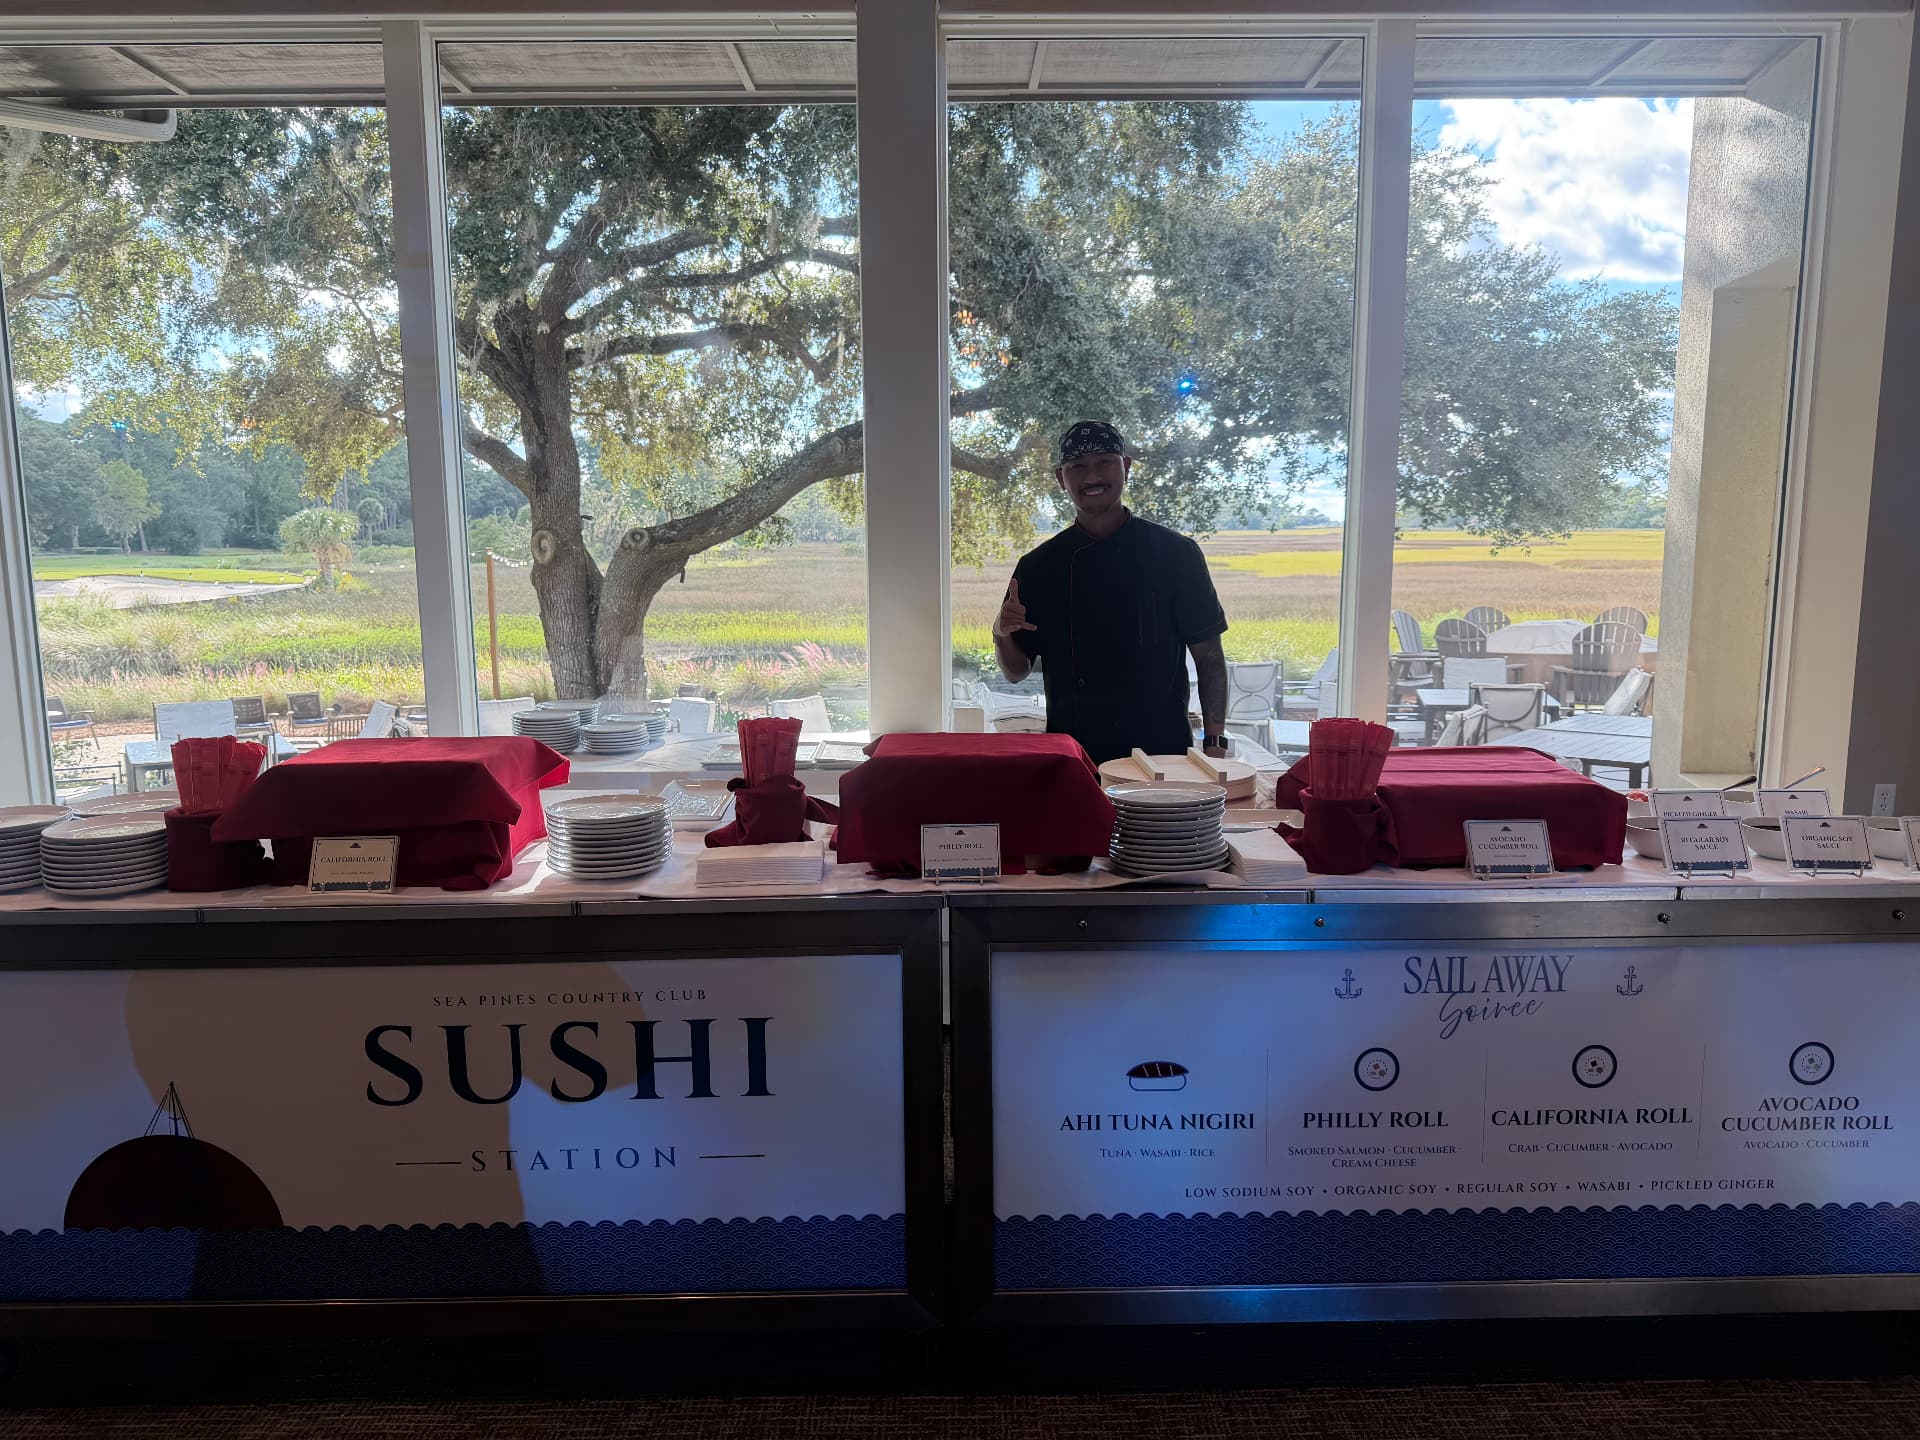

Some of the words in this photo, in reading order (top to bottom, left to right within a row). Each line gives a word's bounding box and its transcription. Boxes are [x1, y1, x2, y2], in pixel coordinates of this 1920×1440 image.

[1489, 835, 1526, 843] AVOCADO
[1694, 843, 1719, 851] SAUCE
[320, 856, 366, 864] CALIFORNIA
[1403, 956, 1476, 994] SAIL
[1481, 955, 1575, 993] AWAY
[433, 995, 468, 1008] SEA
[479, 993, 537, 1007] PINES
[547, 991, 645, 1005] COUNTRY
[655, 989, 708, 1002] CLUB
[364, 1016, 777, 1107] SUSHI
[1758, 1096, 1860, 1112] AVOCADO
[1060, 1114, 1101, 1132] AHI
[1108, 1113, 1174, 1131] TUNA
[1180, 1113, 1256, 1131] NIGIRI
[1302, 1112, 1385, 1129] PHILLY
[1389, 1110, 1449, 1128] ROLL
[1491, 1108, 1629, 1126] CALIFORNIA
[1635, 1107, 1693, 1125] ROLL
[1721, 1115, 1837, 1133] CUCUMBER
[1842, 1114, 1895, 1131] ROLL
[471, 1146, 678, 1173] STATION
[1185, 1187, 1217, 1199] LOW
[1222, 1186, 1281, 1198] SODIUM
[1286, 1185, 1315, 1197] SOY
[1334, 1184, 1404, 1196] ORGANIC
[1408, 1184, 1438, 1195] SOY
[1456, 1182, 1525, 1194] REGULAR
[1529, 1181, 1558, 1193] SOY
[1577, 1180, 1631, 1192] WASABI
[1650, 1179, 1713, 1191] PICKLED
[1718, 1178, 1775, 1190] GINGER
